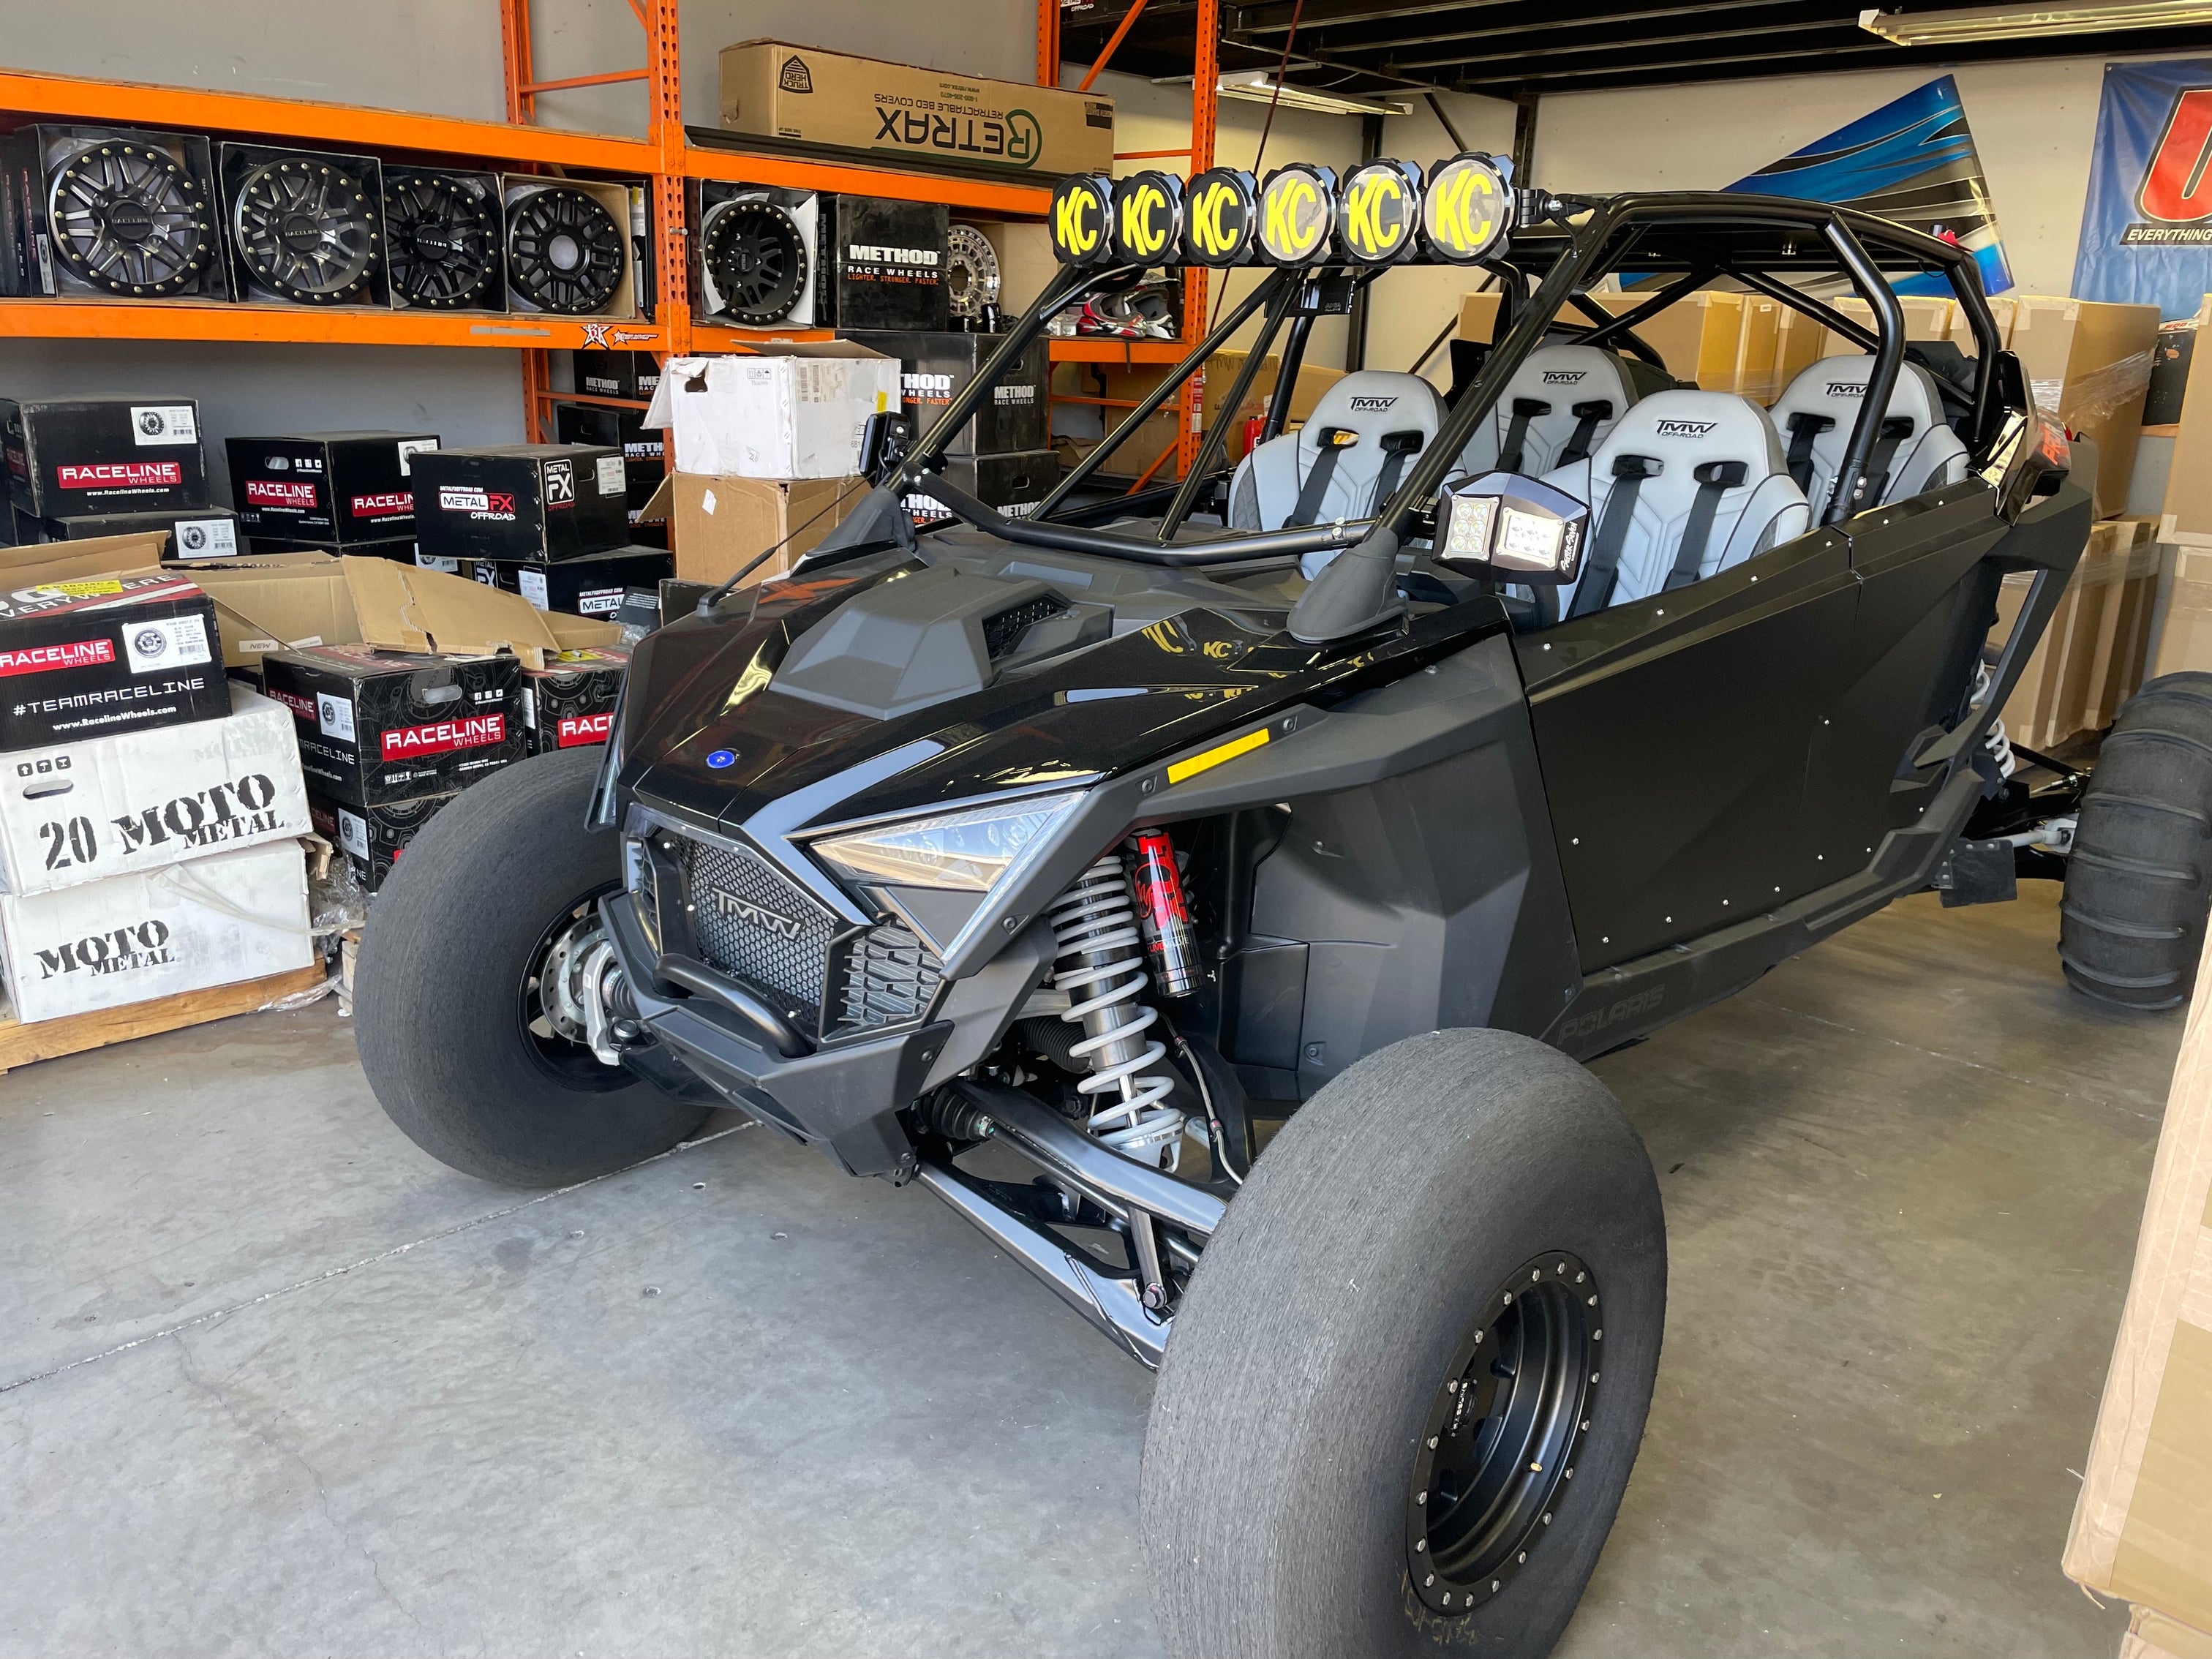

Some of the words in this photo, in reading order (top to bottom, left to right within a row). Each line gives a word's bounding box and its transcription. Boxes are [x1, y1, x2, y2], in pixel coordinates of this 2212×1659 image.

[783, 79, 808, 89] TRUCK
[785, 72, 807, 81] HERO
[874, 94, 913, 107] COVERS
[916, 100, 935, 110] BED
[938, 102, 1004, 119] RETRACTABLE
[875, 107, 1042, 168] RETRAX
[1192, 182, 1238, 255] KC
[1267, 178, 1317, 253] KC
[1349, 174, 1401, 253] KC
[1435, 169, 1491, 252] KC
[1057, 187, 1097, 255] KC
[1121, 184, 1165, 256] KC
[2127, 228, 2212, 241] EVERYTHING
[849, 244, 938, 266] METHOD
[848, 266, 880, 275] RACE
[887, 268, 938, 279] WHEELS
[586, 376, 620, 391] METHOD
[901, 373, 951, 391] HOD
[1543, 372, 1587, 382] TMW
[994, 385, 1034, 399] METHOD
[1351, 397, 1399, 410] TMW
[1657, 419, 1719, 435] TMW
[625, 443, 664, 453] METH
[62, 464, 176, 480] RACELINE
[546, 463, 570, 475] METAL
[128, 475, 177, 484] WHEELS
[547, 473, 573, 502] FX
[86, 488, 170, 497] www.RacelineWheels.com
[247, 483, 314, 499] RACELINE
[286, 497, 315, 506] WHEELS
[354, 495, 414, 510] RACELIN
[396, 503, 415, 511] WHE
[443, 495, 486, 508] METAL
[489, 494, 514, 511] FX
[470, 512, 516, 522] OFFROAD
[249, 642, 271, 651] NEW
[0, 642, 110, 669] RACELINE
[63, 653, 111, 666] WHEELS
[13, 677, 206, 717] #TEAMRACELINE
[52, 705, 178, 731] www.RacelineWheels.com
[385, 715, 501, 750] RACELINE
[454, 731, 502, 748] WHEELS
[110, 773, 276, 855] MOTO
[183, 809, 286, 850] METAL
[40, 816, 98, 871] 20
[711, 886, 802, 941] TMW
[33, 919, 170, 980] MOTO
[90, 947, 176, 977] METAL
[1557, 982, 1666, 1048] POLARIS
